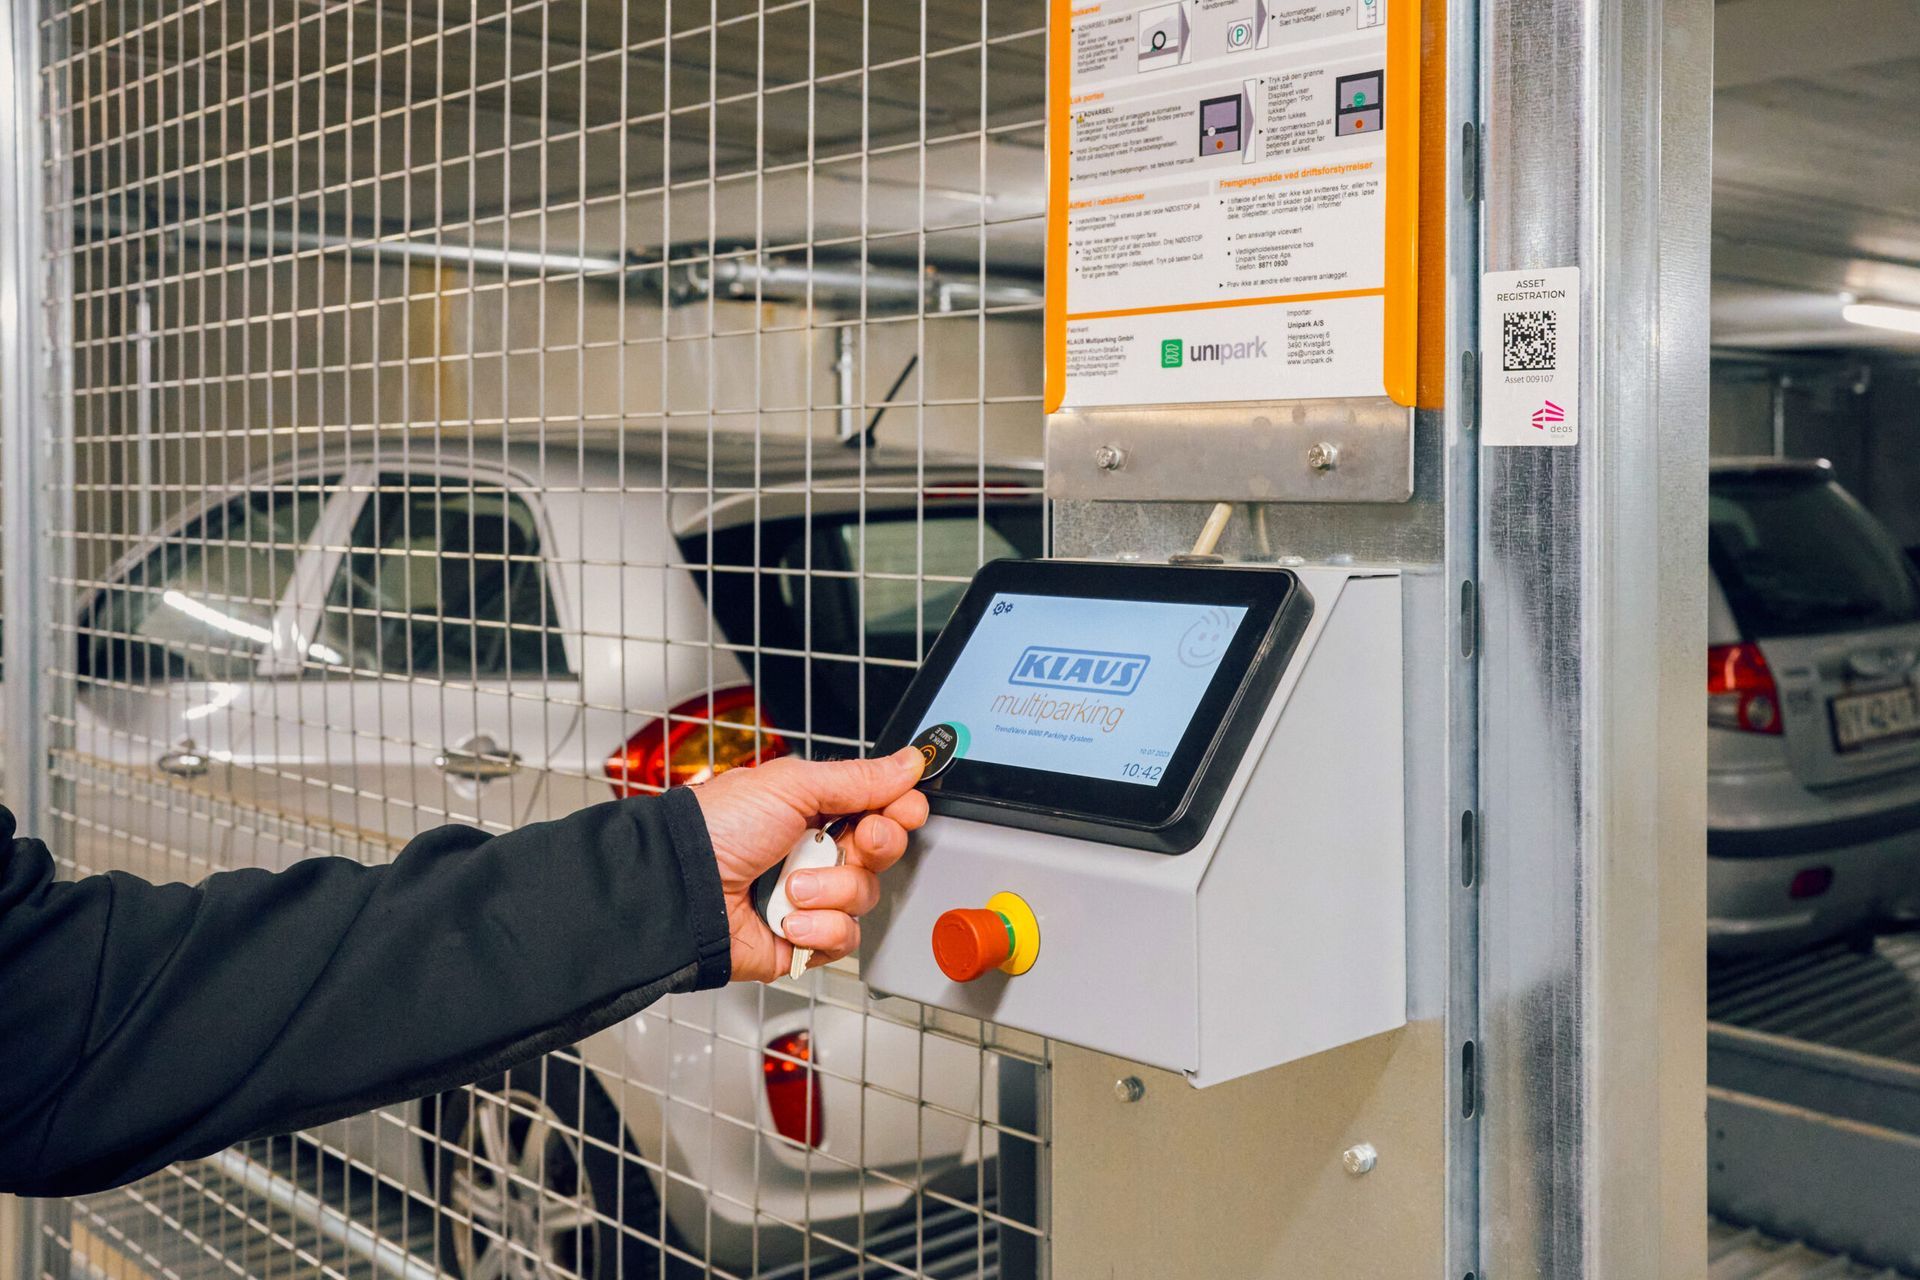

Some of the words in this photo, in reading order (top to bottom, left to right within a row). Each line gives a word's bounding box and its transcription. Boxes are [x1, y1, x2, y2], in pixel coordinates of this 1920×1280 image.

[1268, 75, 1280, 84] Tryk
[1281, 74, 1289, 82] på
[1302, 70, 1323, 79] grønne
[1268, 89, 1294, 99] Displayet
[1266, 132, 1292, 142] anlægget
[1219, 175, 1282, 189] Fremgangsmåde
[1284, 170, 1298, 180] ved
[1301, 161, 1373, 178] driftsforstyrrelser
[1282, 197, 1302, 205] skader
[1303, 196, 1311, 204] på
[1312, 192, 1340, 203] anlægget
[1273, 259, 1288, 267] 0930
[1516, 279, 1546, 289] ASSET
[1497, 290, 1566, 302] REGISTRATION
[1287, 320, 1311, 329] Unipark
[1303, 339, 1330, 348] Kvistgård
[1190, 336, 1268, 365] unipark
[1526, 375, 1554, 383] 009107
[1550, 424, 1573, 433] deas
[1017, 654, 1140, 687] KLAUS
[990, 692, 1124, 732] multiparking
[934, 727, 952, 742] SMILE
[995, 724, 1027, 736] TrendVario
[1044, 730, 1068, 742] Parking
[1069, 734, 1094, 744] System
[932, 736, 948, 750] PARK
[1122, 762, 1162, 780] 10:42
